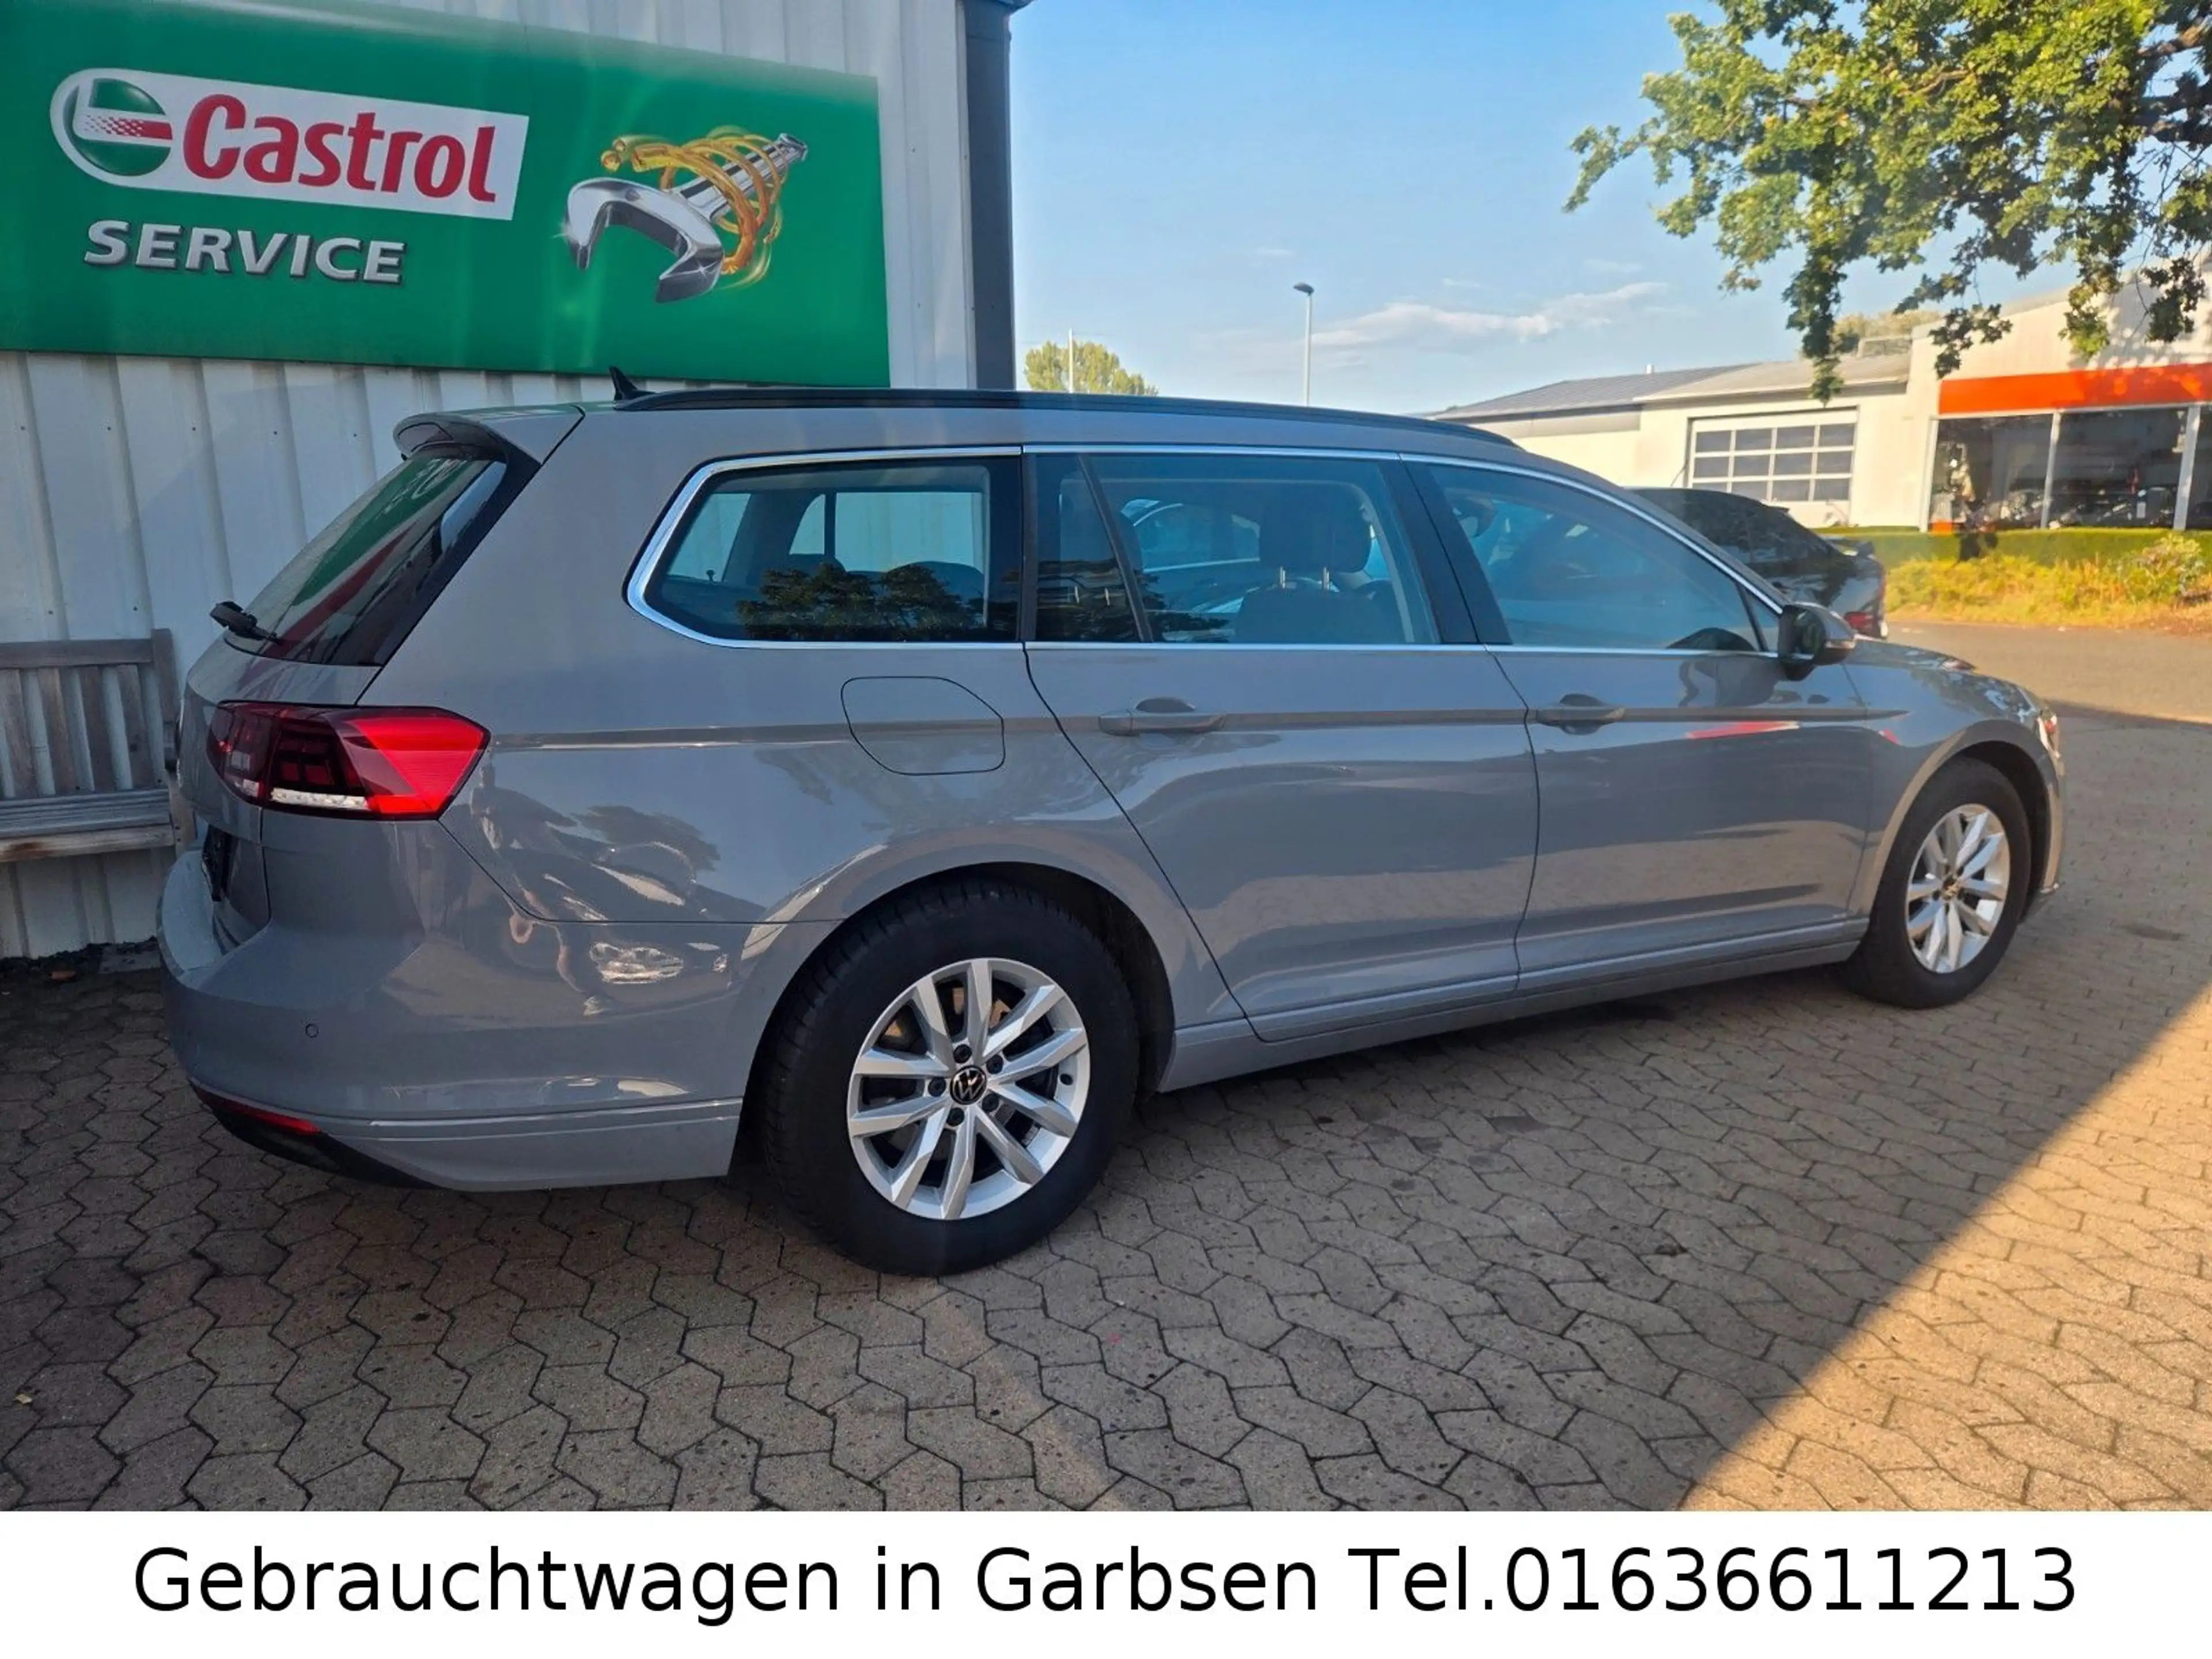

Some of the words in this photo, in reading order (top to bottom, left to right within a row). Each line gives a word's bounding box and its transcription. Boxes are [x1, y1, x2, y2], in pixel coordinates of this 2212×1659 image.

[183, 93, 496, 203] Castrol
[84, 220, 406, 285] SERVICE
[953, 1068, 986, 1101] VW
